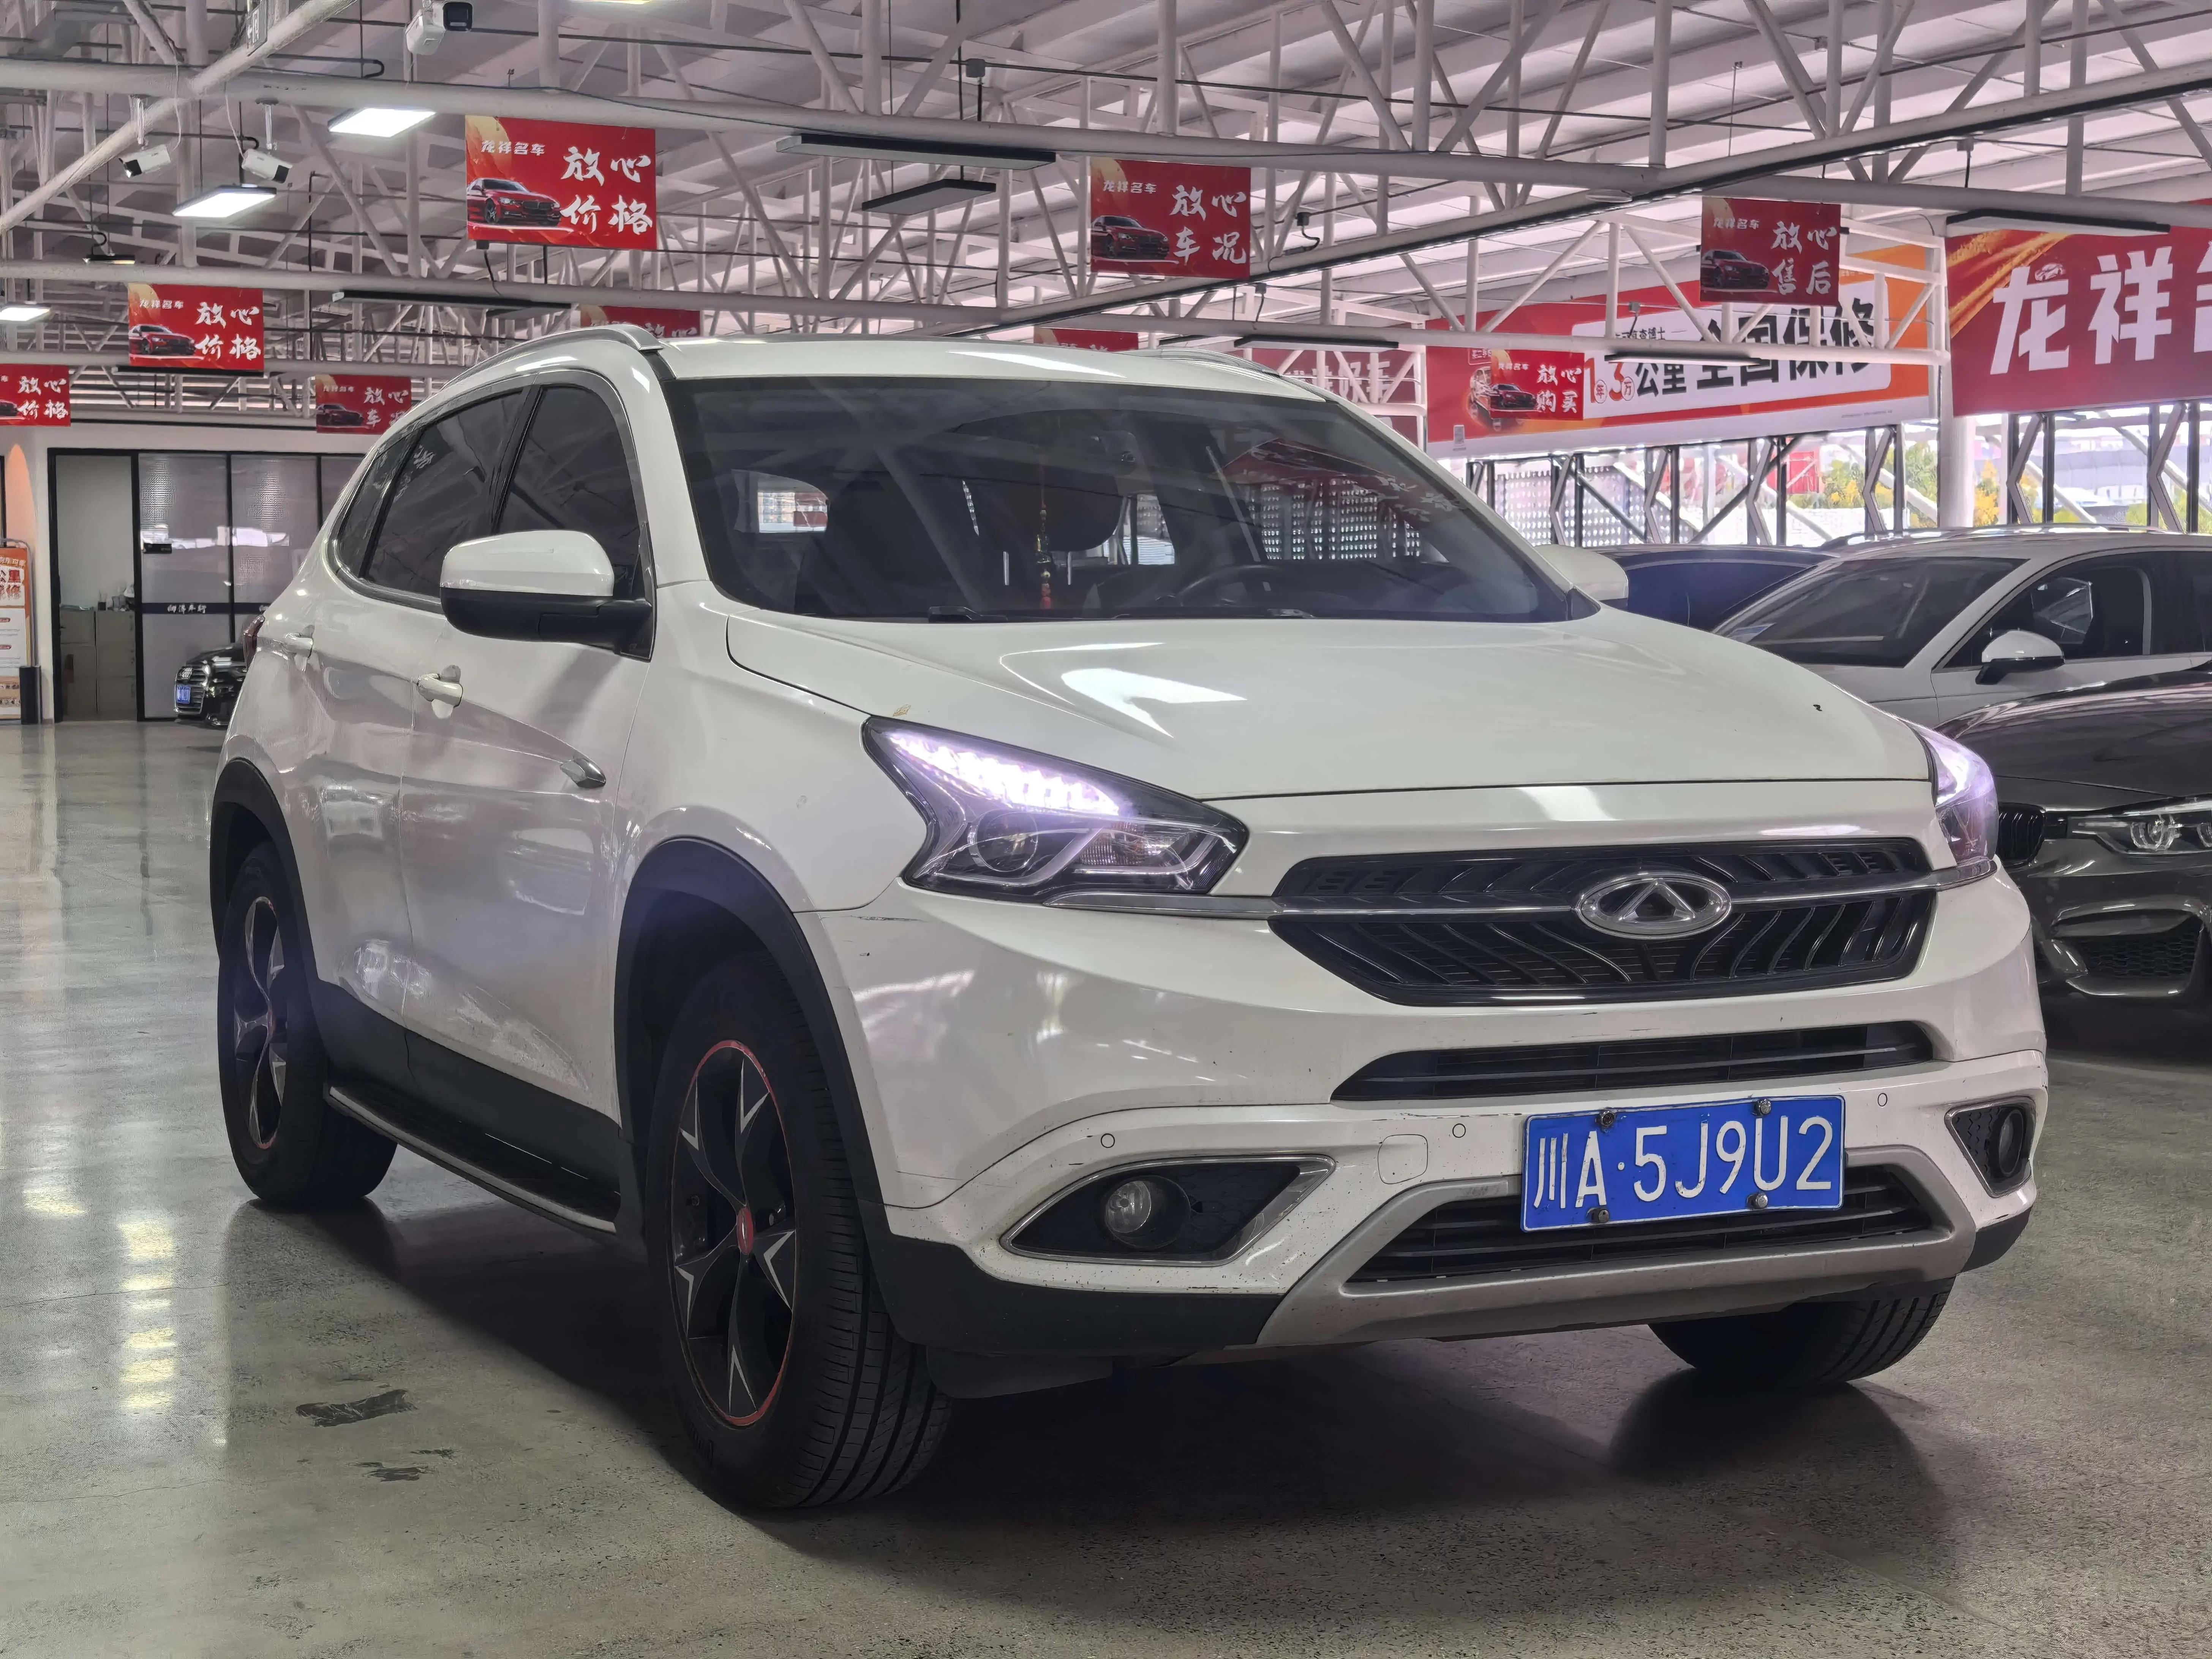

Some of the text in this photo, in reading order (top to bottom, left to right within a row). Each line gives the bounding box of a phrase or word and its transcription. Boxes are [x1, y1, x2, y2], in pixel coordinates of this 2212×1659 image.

[560, 146, 651, 186] 放心
[1103, 180, 1157, 194] 龙祥名车
[560, 194, 653, 235] 价格
[1169, 185, 1247, 221] 放心
[1173, 226, 1247, 265] 车况
[1771, 220, 1837, 254] 放心
[1771, 258, 1831, 295] 售后
[194, 302, 260, 329] 放心
[1990, 240, 2212, 375] 龙祥
[194, 333, 261, 360] 价格
[17, 376, 67, 395] 放心
[1536, 364, 1582, 386] 放心
[17, 400, 68, 419] 价格
[363, 387, 409, 405] 放心
[1536, 390, 1578, 413] 购买
